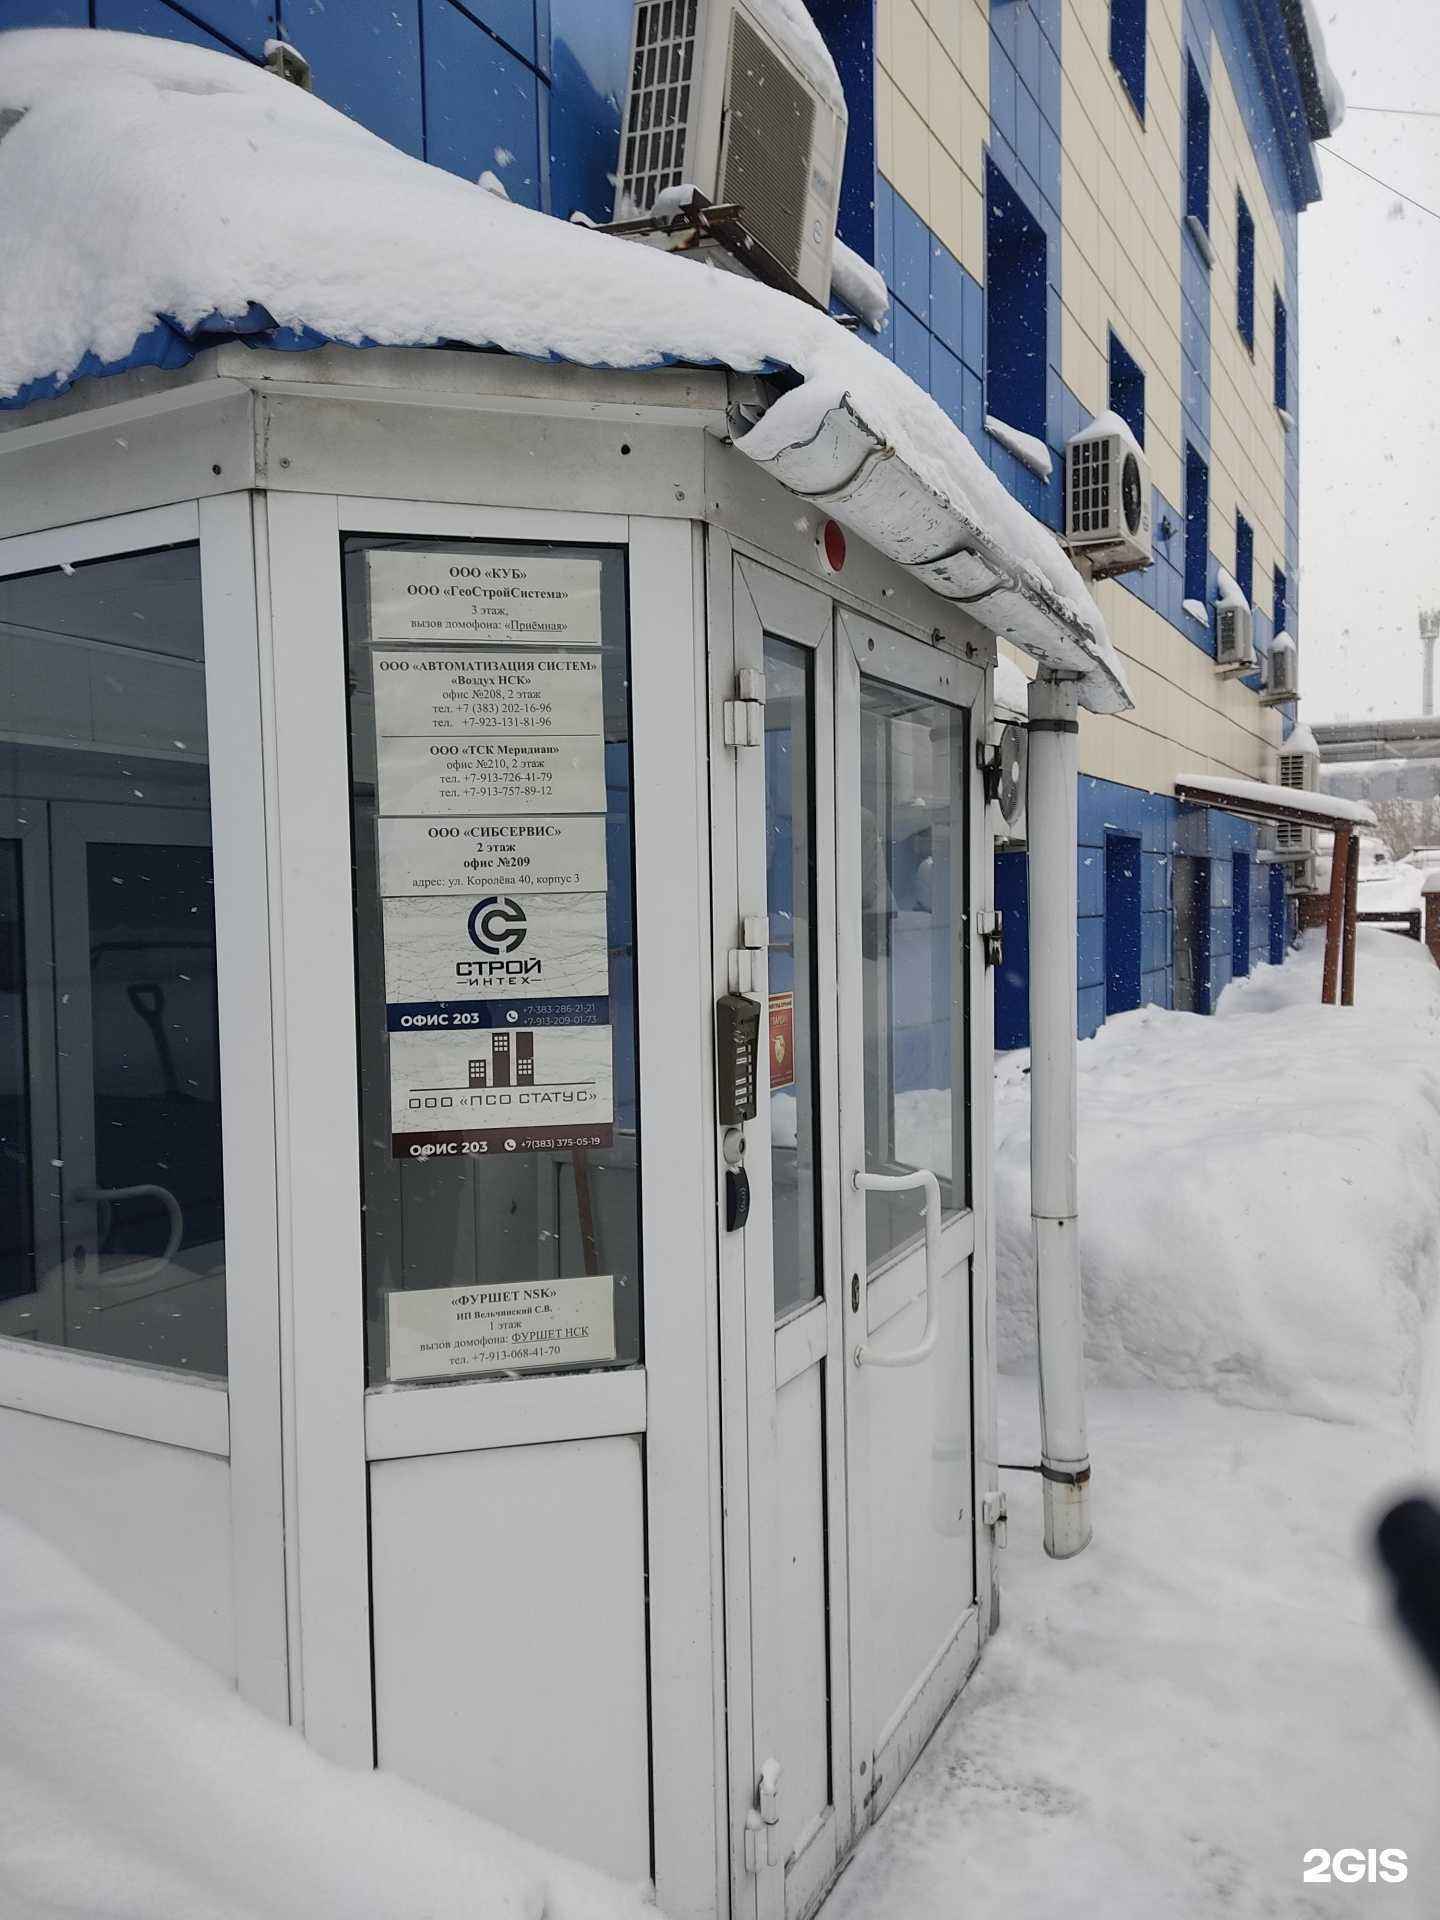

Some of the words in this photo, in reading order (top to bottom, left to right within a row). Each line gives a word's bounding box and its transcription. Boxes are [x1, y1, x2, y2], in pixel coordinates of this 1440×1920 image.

[449, 566, 481, 578] ООО
[484, 568, 527, 580] «КУБ»
[407, 585, 440, 596] ООО
[443, 586, 569, 600] «ГеоСтройСистема»
[472, 605, 478, 615] 3
[411, 620, 442, 628] вызов
[445, 620, 501, 632] домофона:
[504, 620, 568, 632] «Приёмная»
[380, 661, 409, 671] ООО
[413, 661, 536, 672] «АВТОМАТИЗАЦИЯ
[538, 661, 597, 671] СИСТЕМ»
[451, 676, 495, 686] «Воздух
[498, 676, 531, 685] НСК»
[442, 690, 469, 700] офис
[472, 689, 505, 700] №208,
[508, 689, 514, 699] 2
[517, 691, 541, 699] этаж
[432, 705, 453, 713] тел.
[455, 704, 469, 713] +7
[472, 703, 499, 714] (383)
[502, 703, 552, 713] 202-16-96
[432, 719, 453, 727] тел.
[462, 717, 552, 727] +7-923-131-81-96
[430, 746, 459, 755] ООО
[462, 745, 494, 755] «ТСК
[497, 746, 560, 756] Меридиан»
[447, 760, 473, 770] офис
[475, 760, 510, 769] №210,
[512, 759, 518, 768] 2
[521, 760, 544, 768] этаж
[440, 775, 460, 784] тел.
[463, 773, 553, 783] +7-913-726-41-79
[440, 789, 460, 797] тел.
[463, 786, 553, 796] +7-913-757-89-12
[428, 827, 460, 838] ООО
[463, 826, 562, 838] «СИБСЕРВИС»
[477, 843, 484, 852] 2
[487, 843, 516, 852] этаж
[463, 858, 494, 870] офис
[497, 857, 530, 868] №209
[412, 878, 445, 888] адрес:
[448, 879, 463, 888] ул.
[466, 874, 516, 887] Королёва
[518, 875, 534, 885] 40,
[536, 875, 572, 885] корпус
[575, 874, 580, 883] 3
[456, 958, 542, 976] СТРОЙ
[400, 1014, 449, 1026] ОФИС
[452, 1013, 480, 1025] 203
[409, 1097, 453, 1109] ООО
[459, 1094, 512, 1106] «ПСО
[519, 1091, 597, 1104] СТАТУС»
[410, 1143, 457, 1156] ОФИС
[462, 1141, 488, 1153] 203
[521, 1139, 555, 1149] +7(383)
[556, 1137, 600, 1147] 375-05-19
[451, 1290, 520, 1306] «ФУРШЕТ
[523, 1288, 557, 1300] NSK»
[457, 1312, 472, 1321] ИП
[498, 1322, 522, 1330] этаж
[420, 1341, 451, 1351] вызов
[454, 1336, 509, 1349] домофона:
[511, 1329, 562, 1344] ФУРШЕТ
[565, 1326, 589, 1338] НСК
[450, 1356, 469, 1365] тел.
[472, 1346, 561, 1362] +7-913-068-41-70
